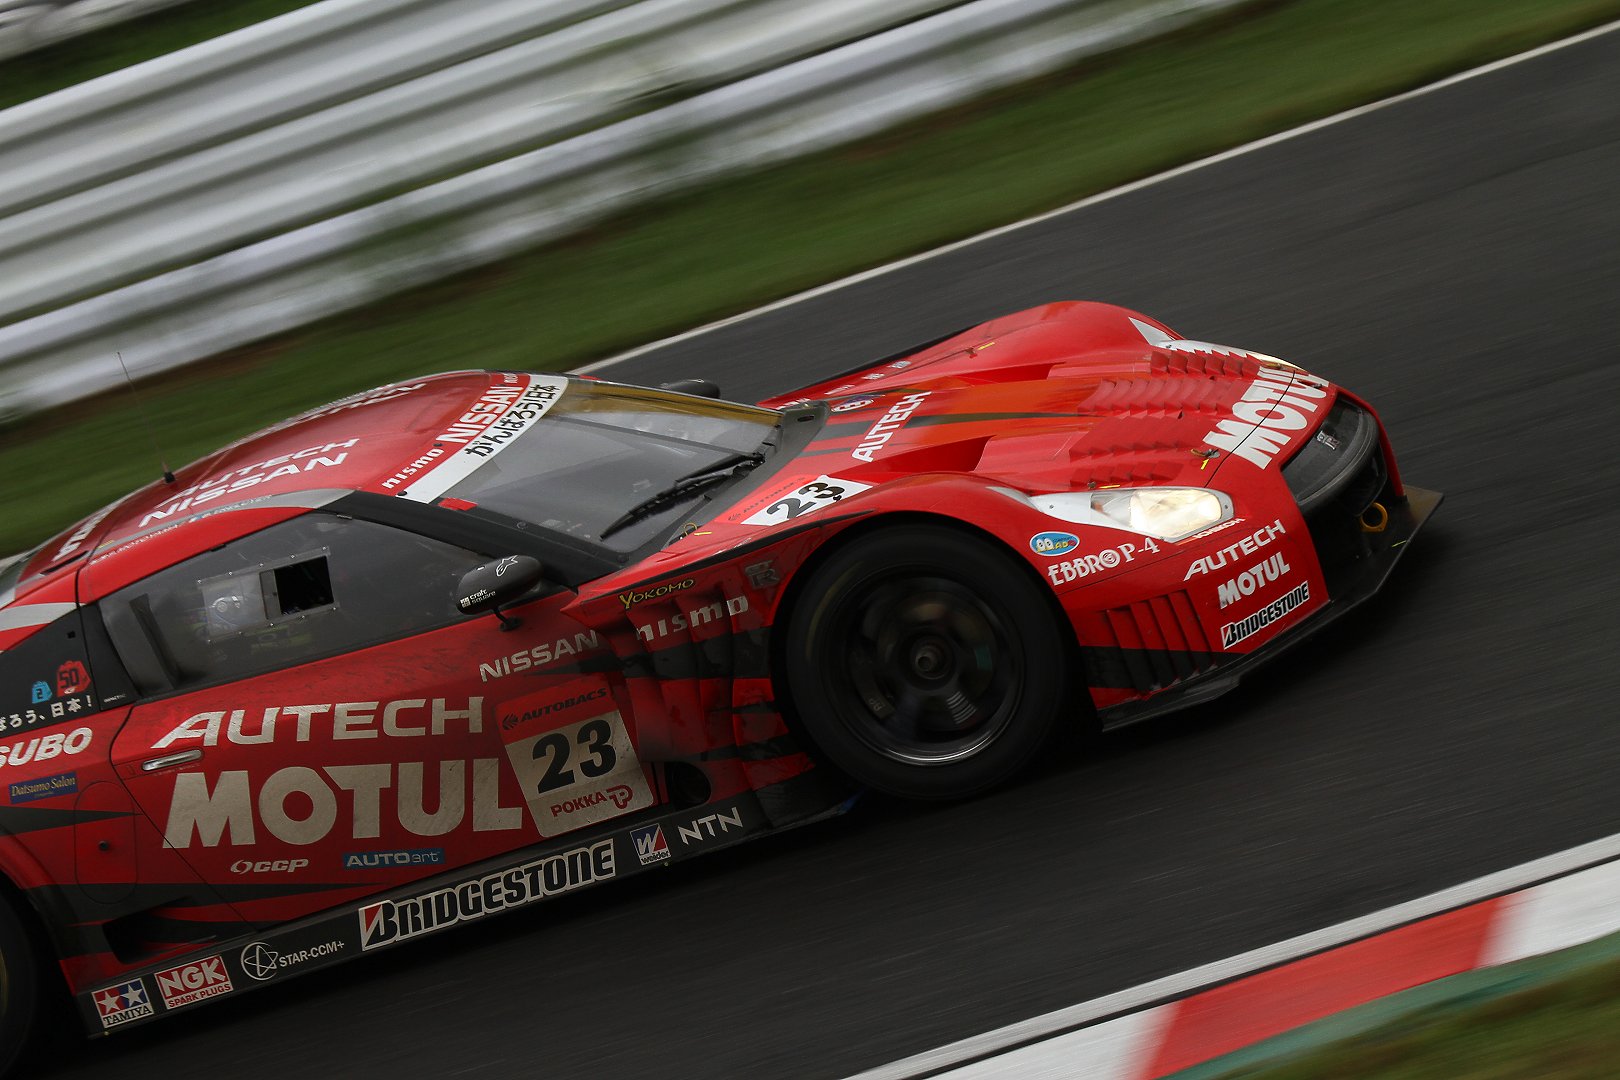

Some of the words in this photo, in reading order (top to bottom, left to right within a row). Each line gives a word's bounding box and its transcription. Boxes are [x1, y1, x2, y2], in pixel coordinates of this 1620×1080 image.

[436, 386, 525, 444] NISSAN
[852, 391, 932, 463] AUTECH
[138, 452, 349, 529] NISSAN
[381, 448, 445, 489] nismo
[766, 482, 846, 519] 23
[1048, 549, 1121, 586] EBBRO
[1117, 537, 1161, 563] P-4
[1183, 519, 1287, 581] AUTECH
[1217, 552, 1290, 610] MOTUL
[635, 595, 749, 642] nismo
[1220, 580, 1311, 650] BRIDGESTONE
[479, 628, 598, 682] NISSAN
[150, 697, 484, 749] AUTECH
[520, 687, 608, 723] AUTOBACS
[532, 719, 617, 794] 23
[51, 775, 76, 789] Salon
[162, 758, 523, 849] MOTUL
[550, 791, 608, 818] POKKA
[678, 807, 744, 845] NTN
[346, 851, 439, 867] AUTOart
[358, 838, 616, 952] BRIDGESTONE
[159, 958, 226, 998] NGK
[278, 940, 345, 968] STAR-CCM+
[103, 1005, 152, 1026] TAMIYA
[168, 993, 199, 1008] SPARK
[200, 983, 231, 998] PLUGS
